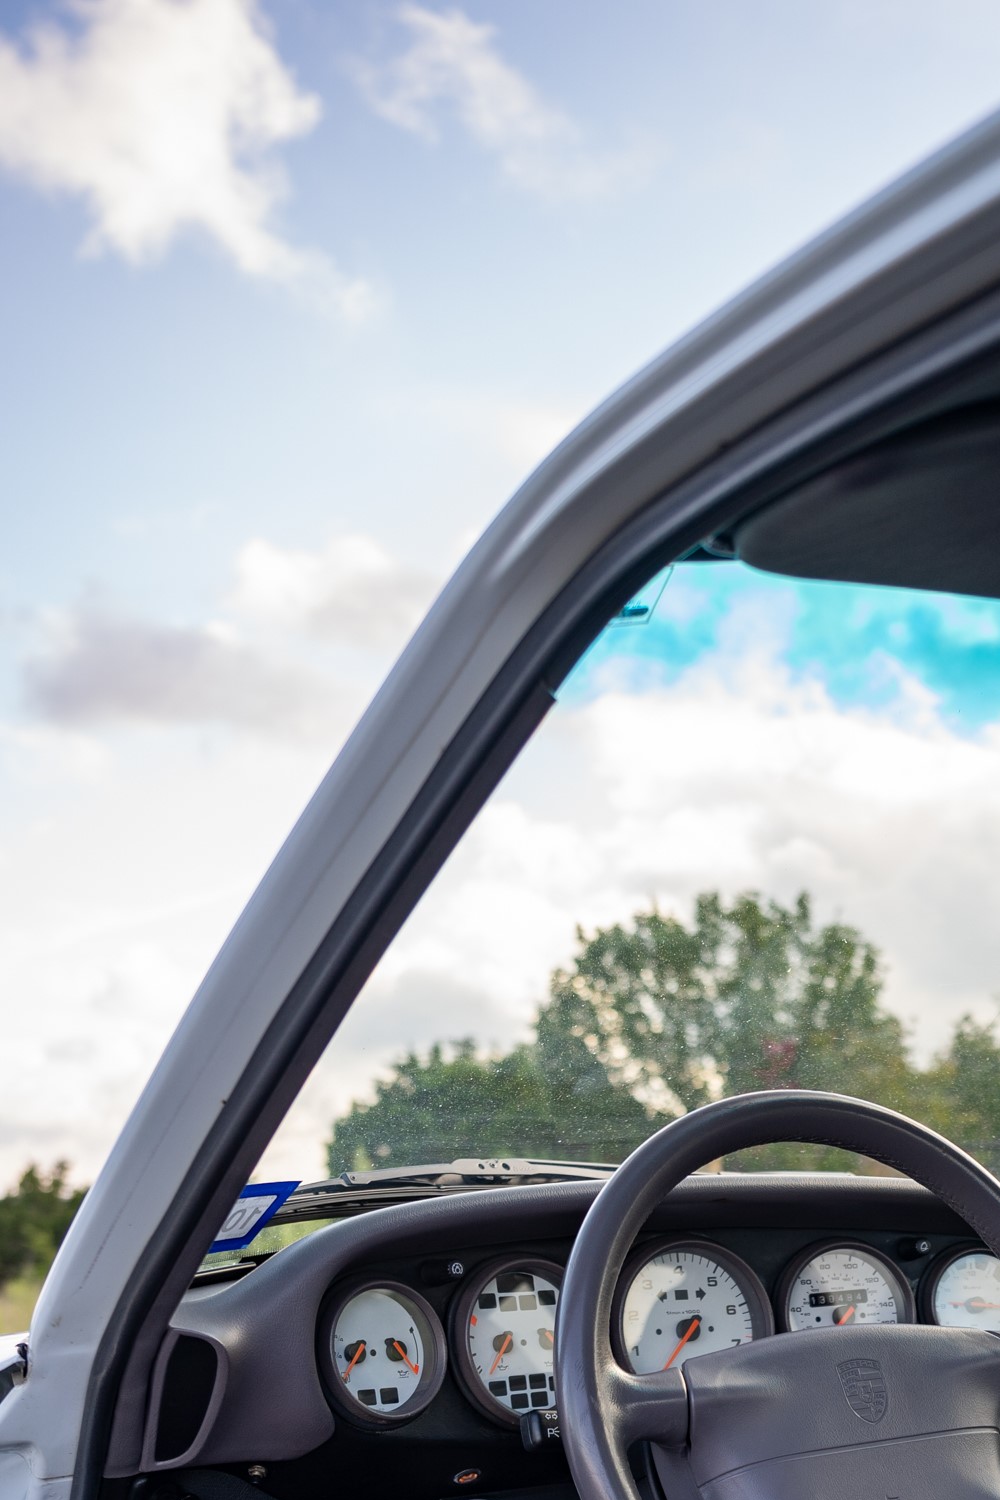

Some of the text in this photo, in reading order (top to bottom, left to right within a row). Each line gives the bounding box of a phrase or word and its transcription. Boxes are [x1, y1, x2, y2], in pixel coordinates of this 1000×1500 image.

[673, 1265, 684, 1275] 4
[642, 1279, 653, 1290] 3
[707, 1276, 718, 1287] 5
[628, 1310, 639, 1321] 2
[726, 1305, 736, 1315] 6
[632, 1345, 639, 1356] 1
